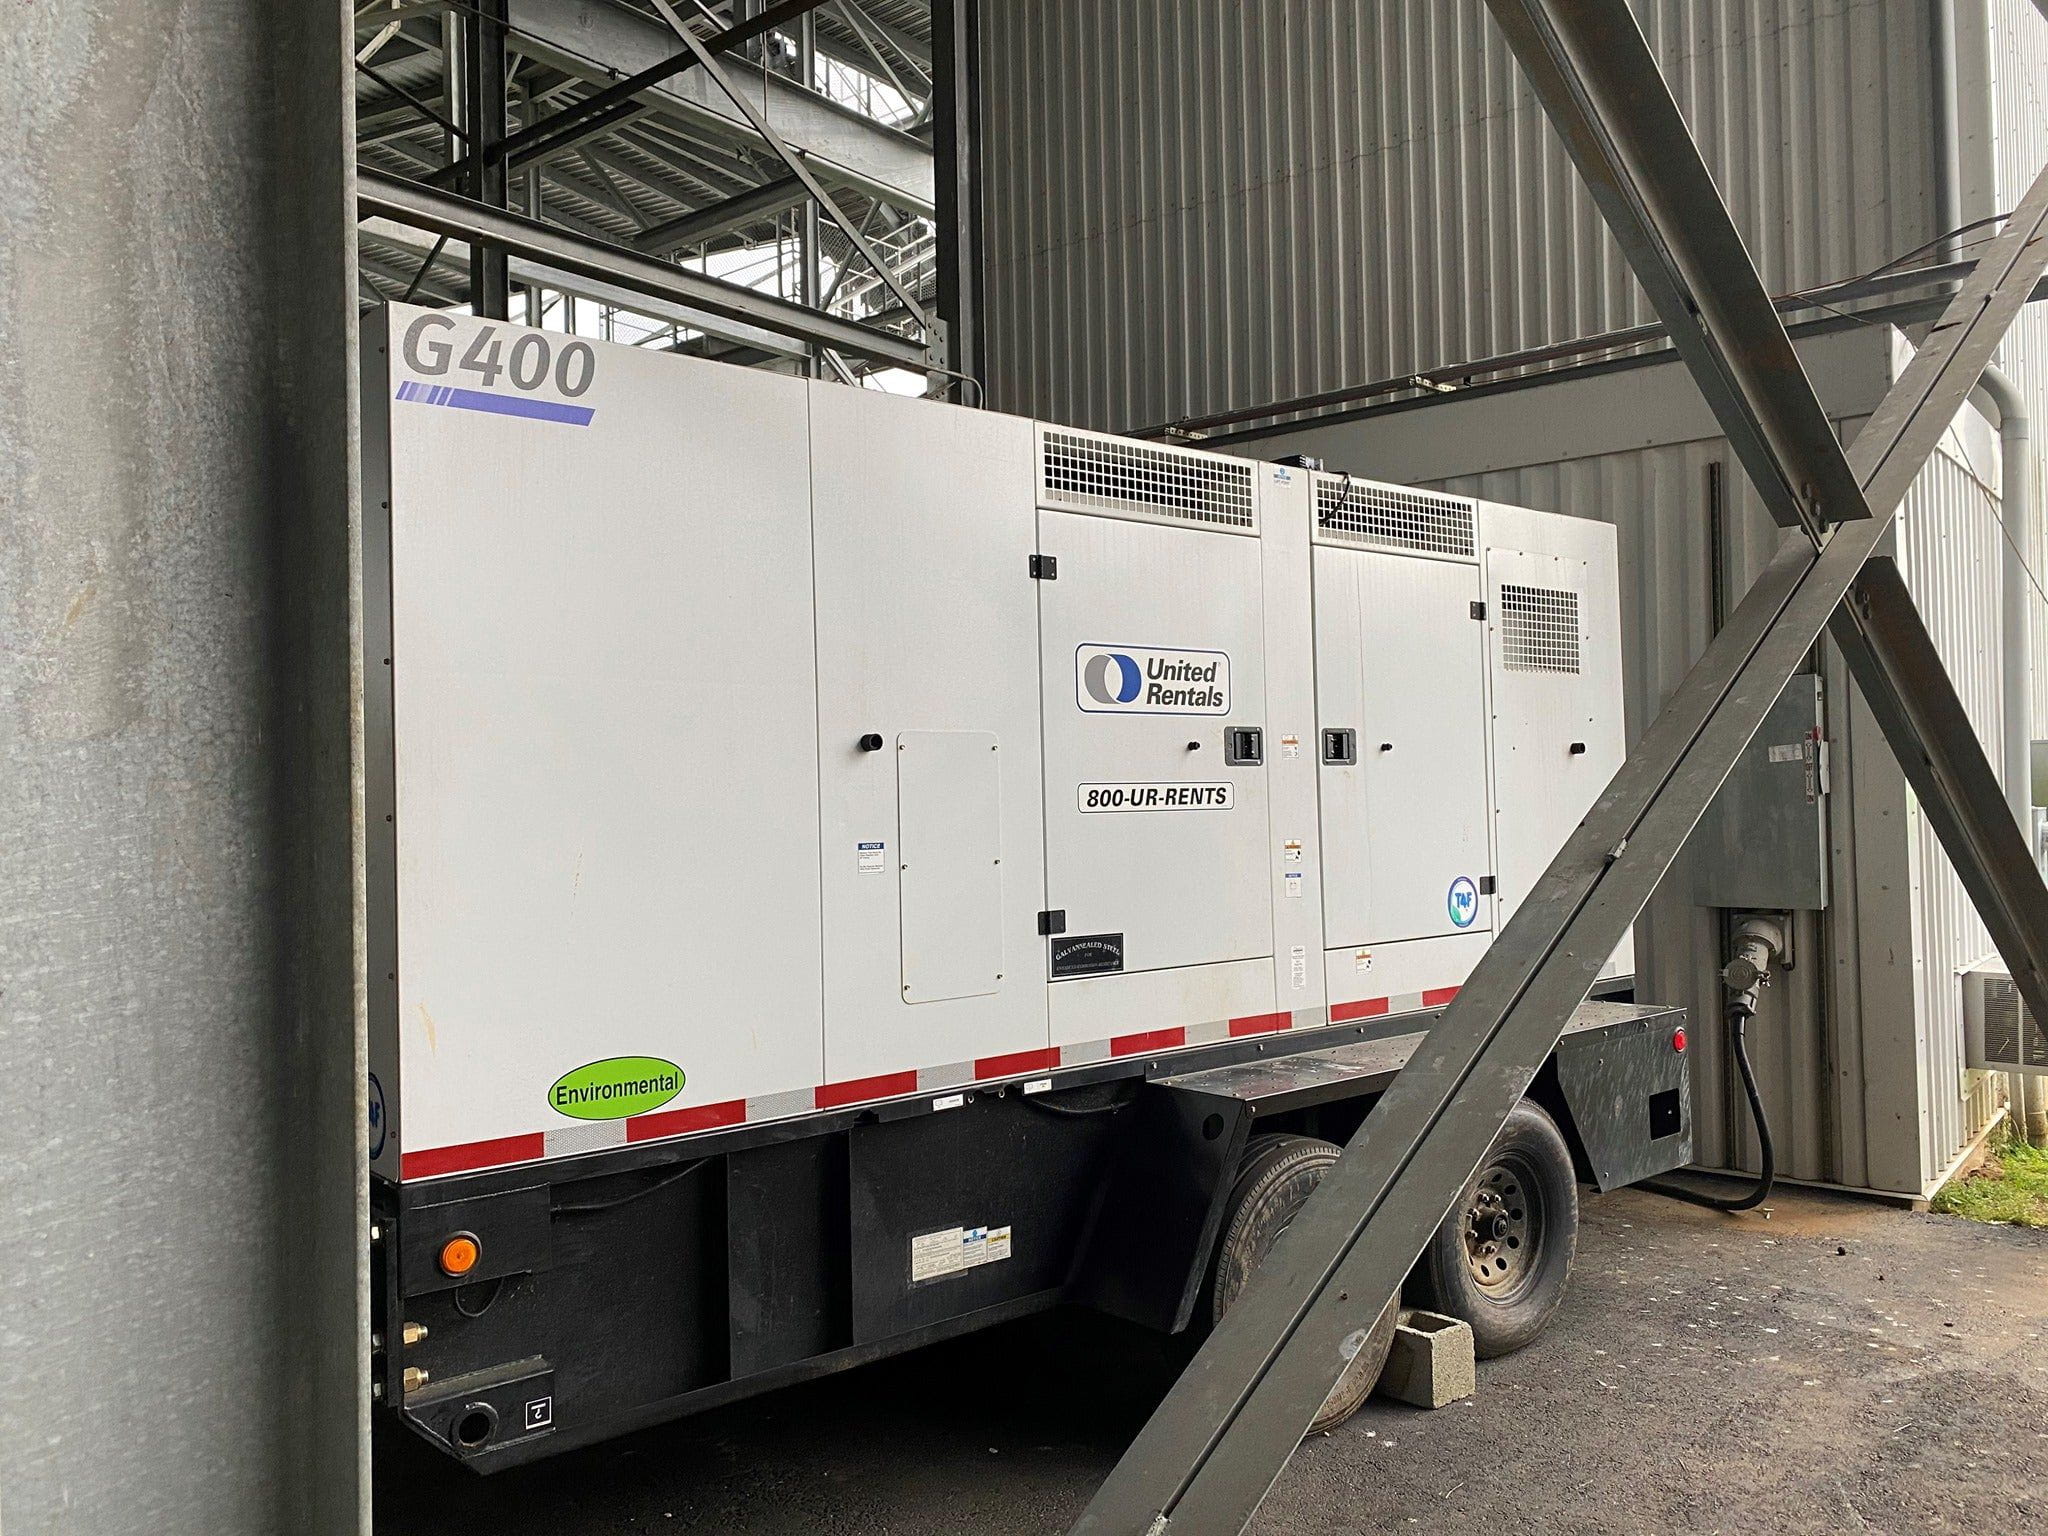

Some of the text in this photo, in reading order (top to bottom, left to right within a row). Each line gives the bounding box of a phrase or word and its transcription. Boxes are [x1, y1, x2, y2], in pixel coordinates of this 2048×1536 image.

[403, 314, 595, 397] G400
[1147, 658, 1217, 682] United
[1146, 683, 1223, 707] Rentals
[1086, 787, 1227, 808] 800-UR-RENTS
[556, 1071, 679, 1106] Environmental
